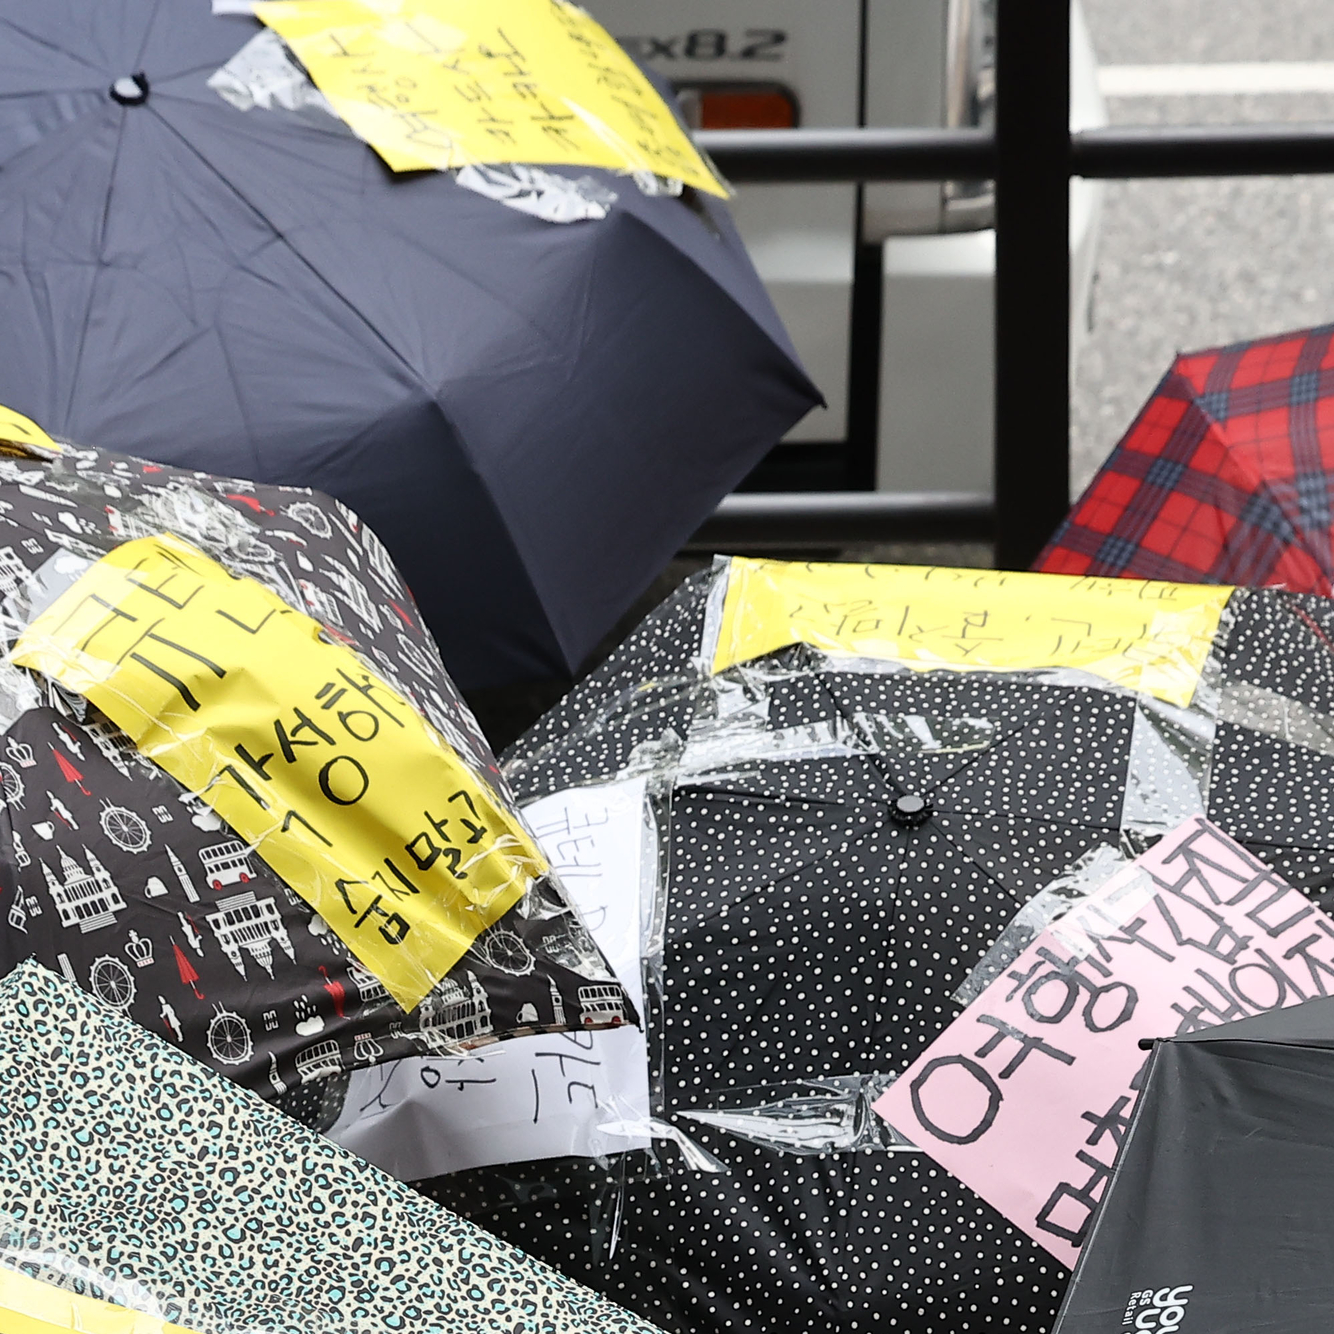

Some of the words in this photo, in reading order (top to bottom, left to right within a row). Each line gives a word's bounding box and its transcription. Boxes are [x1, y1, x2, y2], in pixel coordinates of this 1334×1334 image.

[331, 789, 485, 947] 숨지말고
[1121, 1291, 1143, 1326] Retail
[1139, 1289, 1155, 1307] GS
